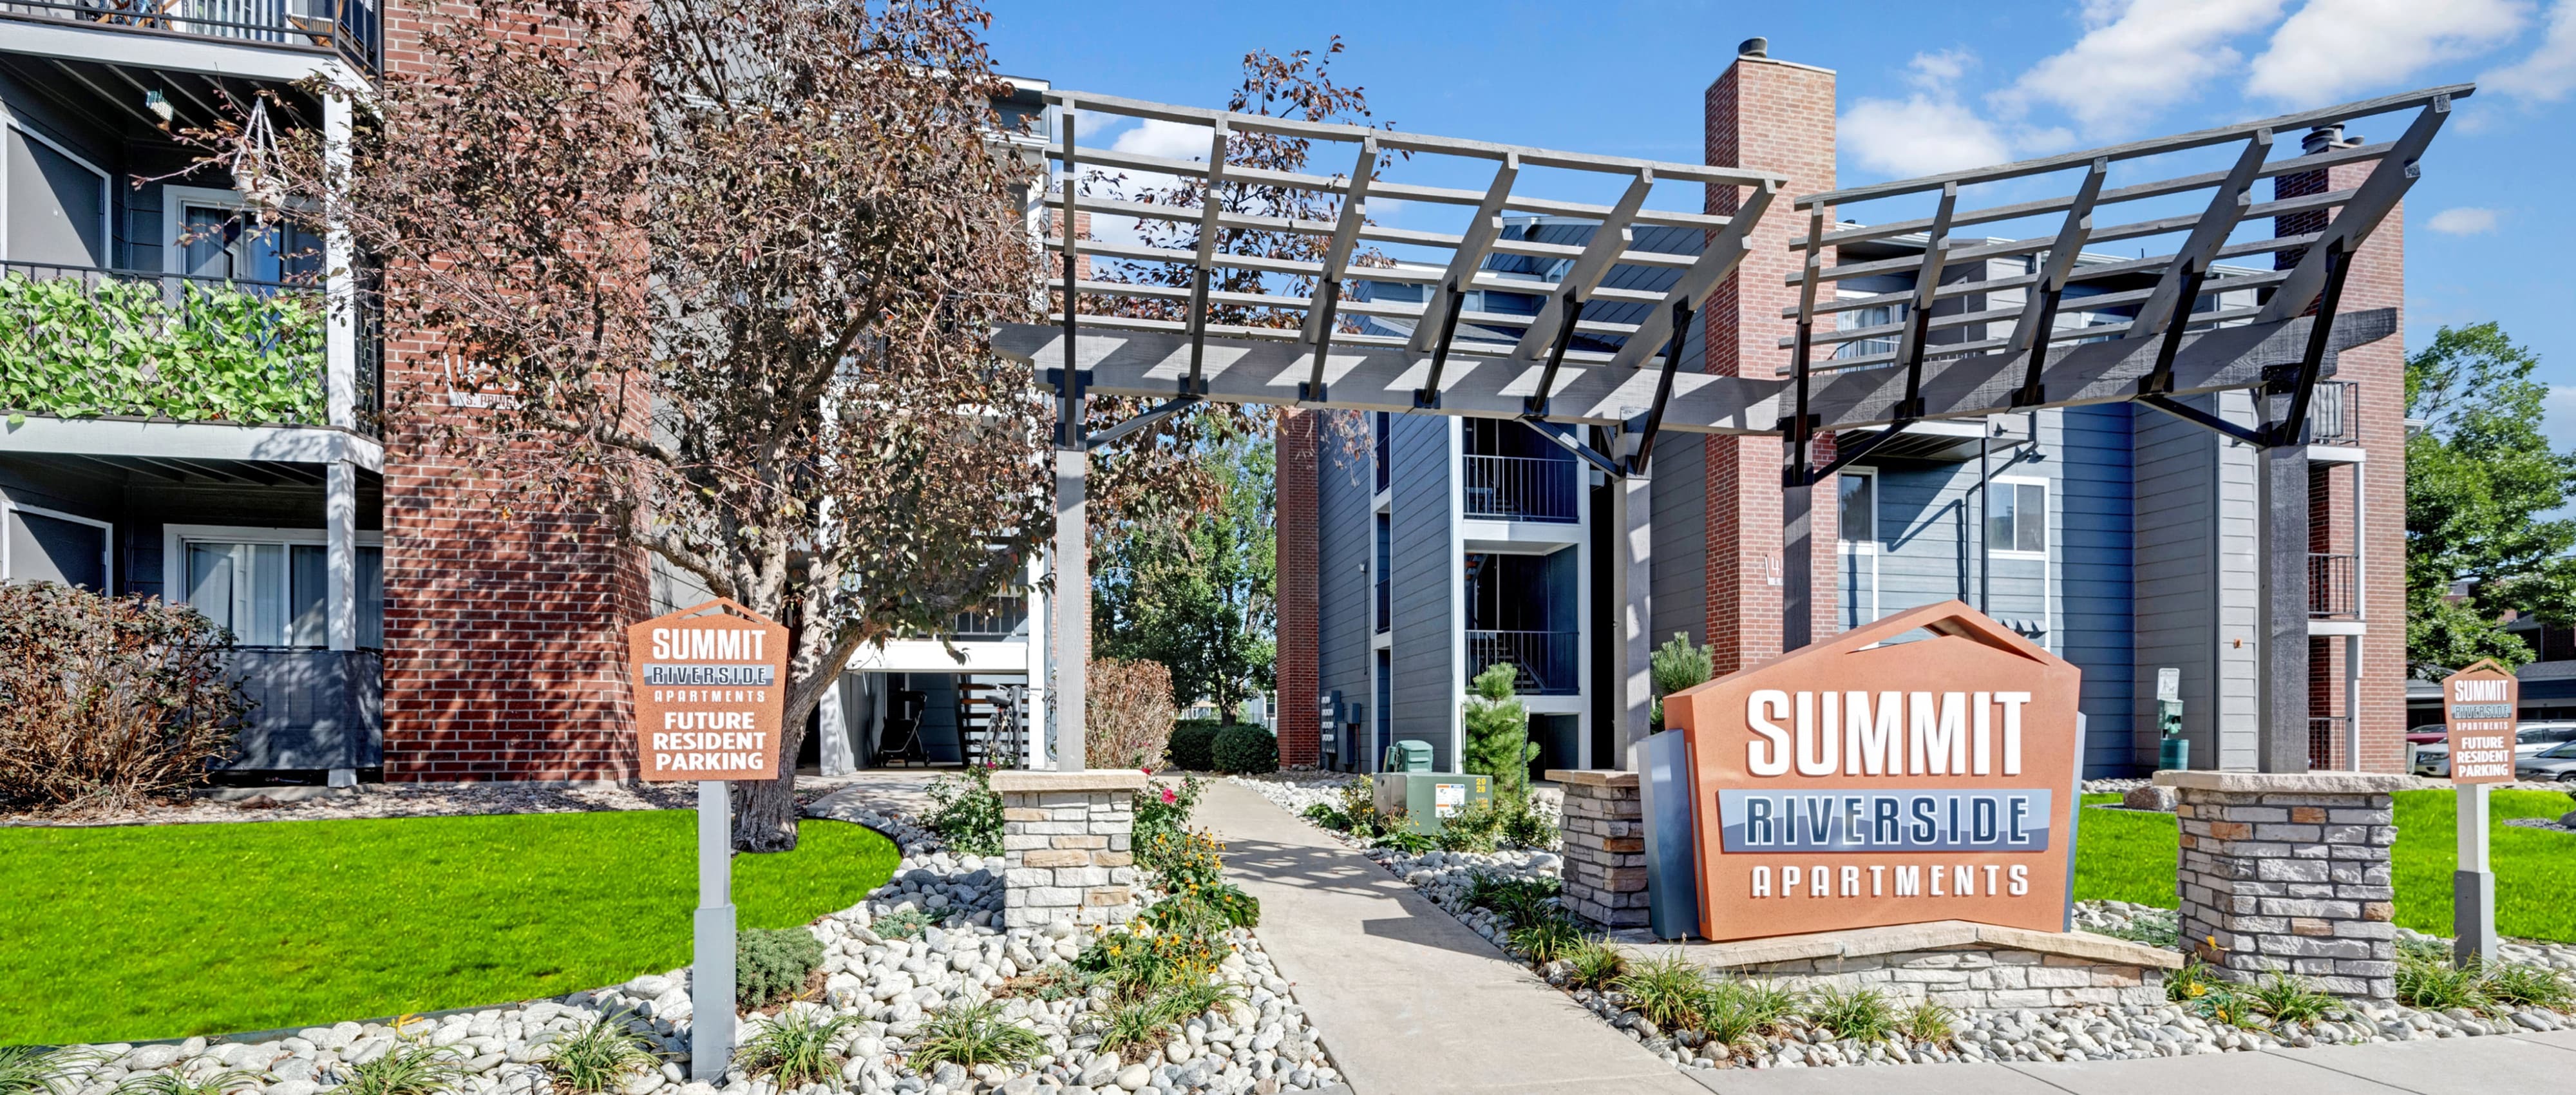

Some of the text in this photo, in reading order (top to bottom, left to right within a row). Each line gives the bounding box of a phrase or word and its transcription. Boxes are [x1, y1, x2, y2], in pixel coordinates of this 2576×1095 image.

[652, 627, 766, 660] SUMMIT
[652, 665, 766, 684] RIVERSIDE
[654, 690, 765, 702] APARTMENTS
[2454, 680, 2508, 701] SUMMIT
[2454, 705, 2510, 718] RIVERSIDE
[665, 712, 755, 730] FUTURE
[2456, 721, 2508, 731] APARTMENTS
[653, 732, 766, 750] RESIDENT
[1747, 689, 2031, 777] SUMMIT
[2461, 736, 2504, 749] FUTURE
[656, 752, 763, 770] PARKING
[2456, 750, 2509, 763] RESIDENT
[2458, 764, 2508, 777] PARKING
[1745, 795, 2029, 846] RIVERSIDE
[1750, 864, 2029, 898] APARTMENTS
